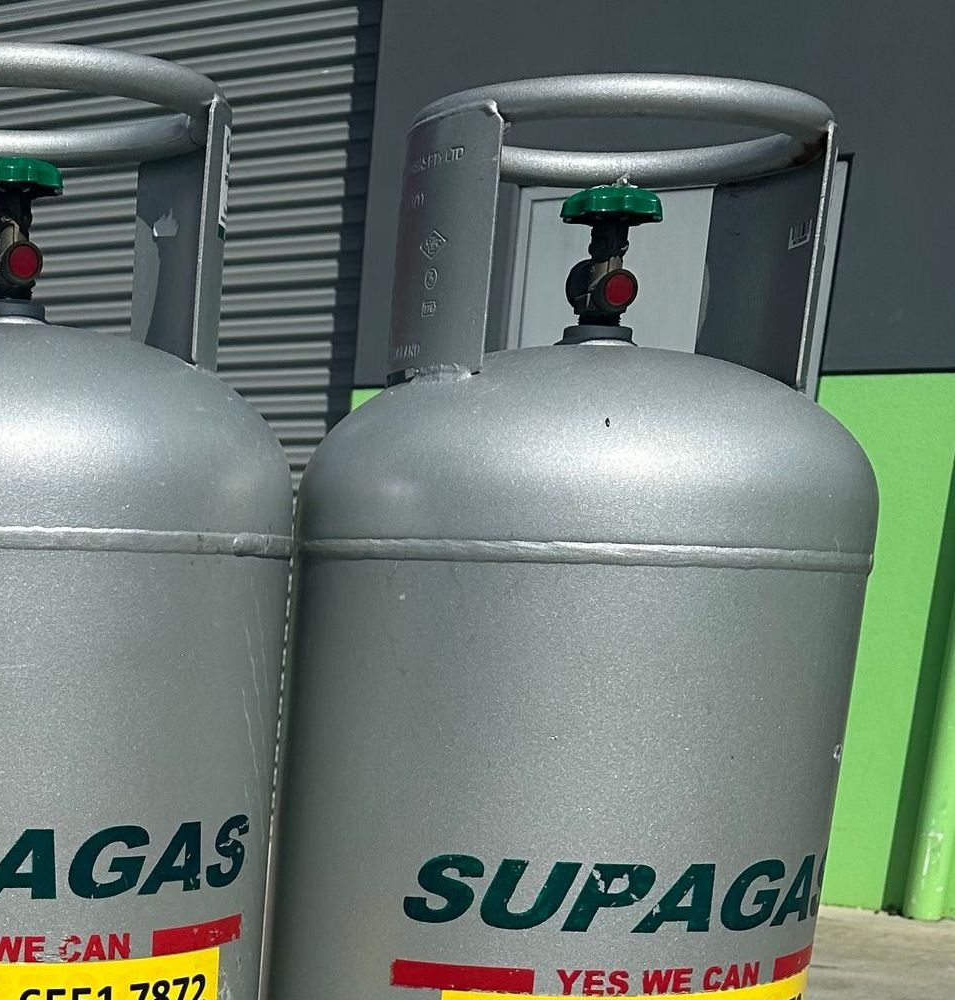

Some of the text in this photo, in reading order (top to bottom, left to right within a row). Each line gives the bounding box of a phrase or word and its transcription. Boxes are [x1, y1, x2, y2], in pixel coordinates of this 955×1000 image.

[59, 932, 131, 962] CAN
[557, 962, 759, 996] YES WE CAN
